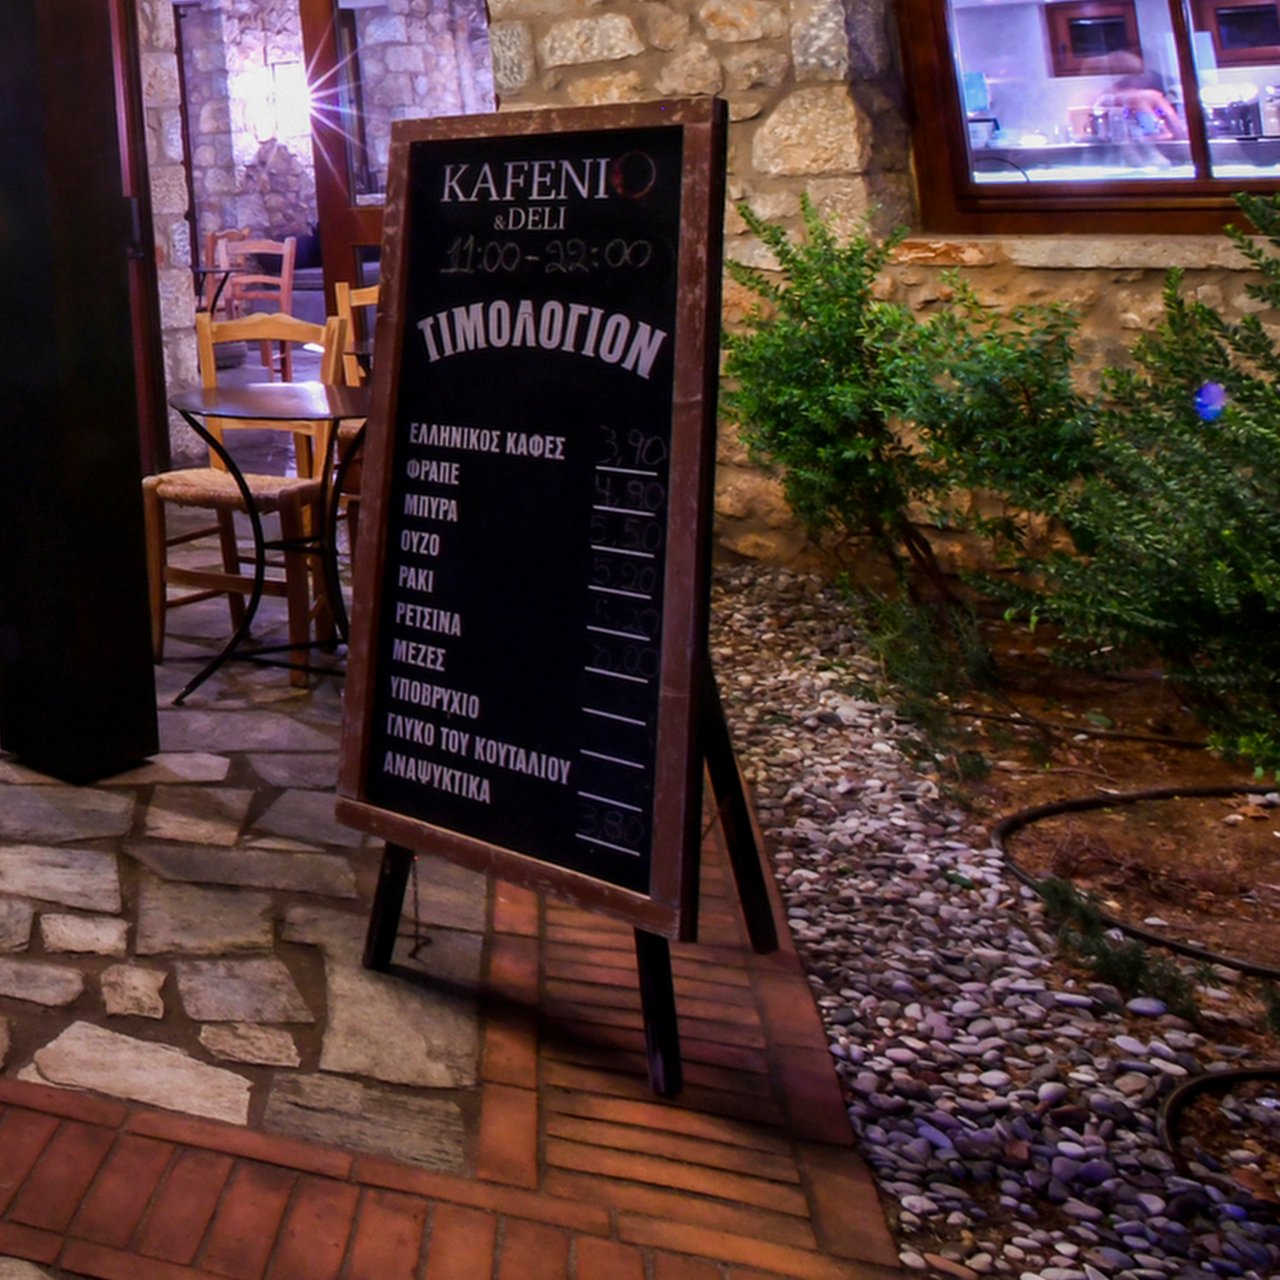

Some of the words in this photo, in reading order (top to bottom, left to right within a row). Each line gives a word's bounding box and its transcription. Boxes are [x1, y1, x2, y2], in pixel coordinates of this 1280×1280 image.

[440, 150, 657, 203] KAFENIO
[417, 299, 668, 380] ΤΙΜΟΛΟΓΙΟΝ
[409, 422, 501, 453] ΕΛΛΗΝΙΚΟΣ
[505, 431, 566, 460] ΚΑΦΕΣ
[406, 458, 460, 485] ΦΡΑΠΕ
[404, 493, 458, 522] ΜΠΥΡΑ
[400, 529, 440, 557] ΟΥΖΟ
[398, 565, 434, 593] ΡΑΚΙ
[395, 601, 461, 637] ΡΕΤΣΙΝΑ
[392, 638, 446, 672] ΜΕΖΕΣ
[390, 675, 480, 719] ΥΠΟΒΡΥΧΙΟ
[387, 712, 435, 747] ΓΛΥΚΟ
[440, 726, 470, 756] ΤΟΥ
[474, 735, 571, 785] ΚΟΥΤΑΛΙΟΥ
[383, 751, 491, 804] ΑΝΑΨΥΚΤΙΚΑ
